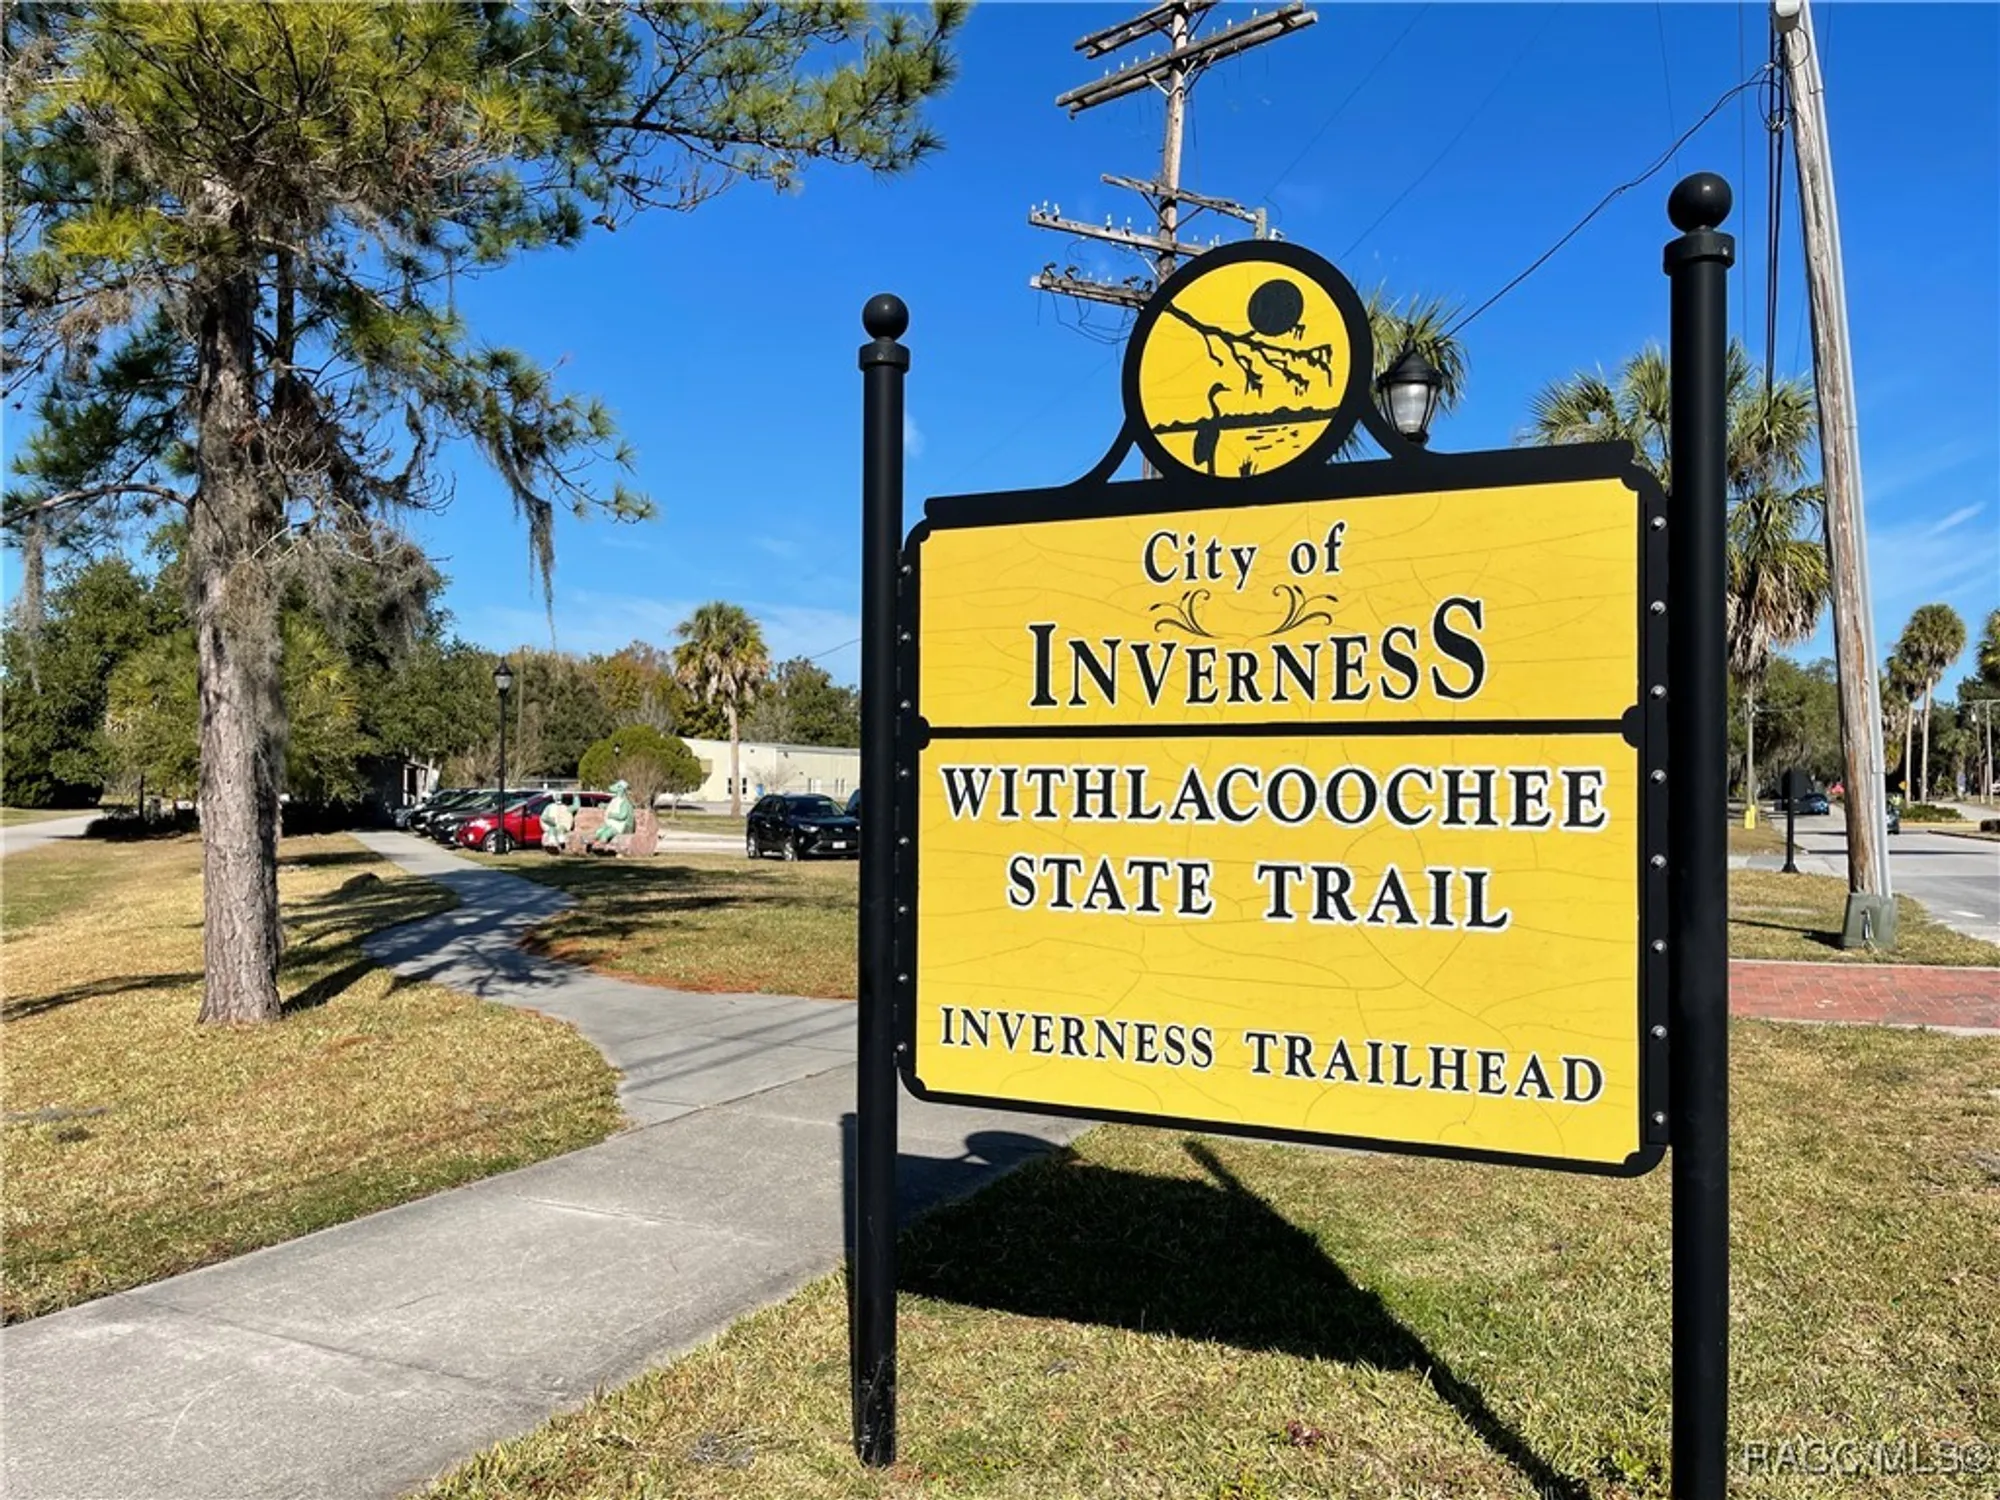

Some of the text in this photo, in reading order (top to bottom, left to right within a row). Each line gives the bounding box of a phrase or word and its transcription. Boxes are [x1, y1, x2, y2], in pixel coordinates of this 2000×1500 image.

[1144, 521, 1345, 590] City of
[1030, 597, 1485, 707] INVERNESS
[941, 767, 1606, 829] WITHLACOOCHEE
[1008, 856, 1507, 929] STATE TRAIL
[941, 1007, 1603, 1102] INVERNESS TRAILHEAD
